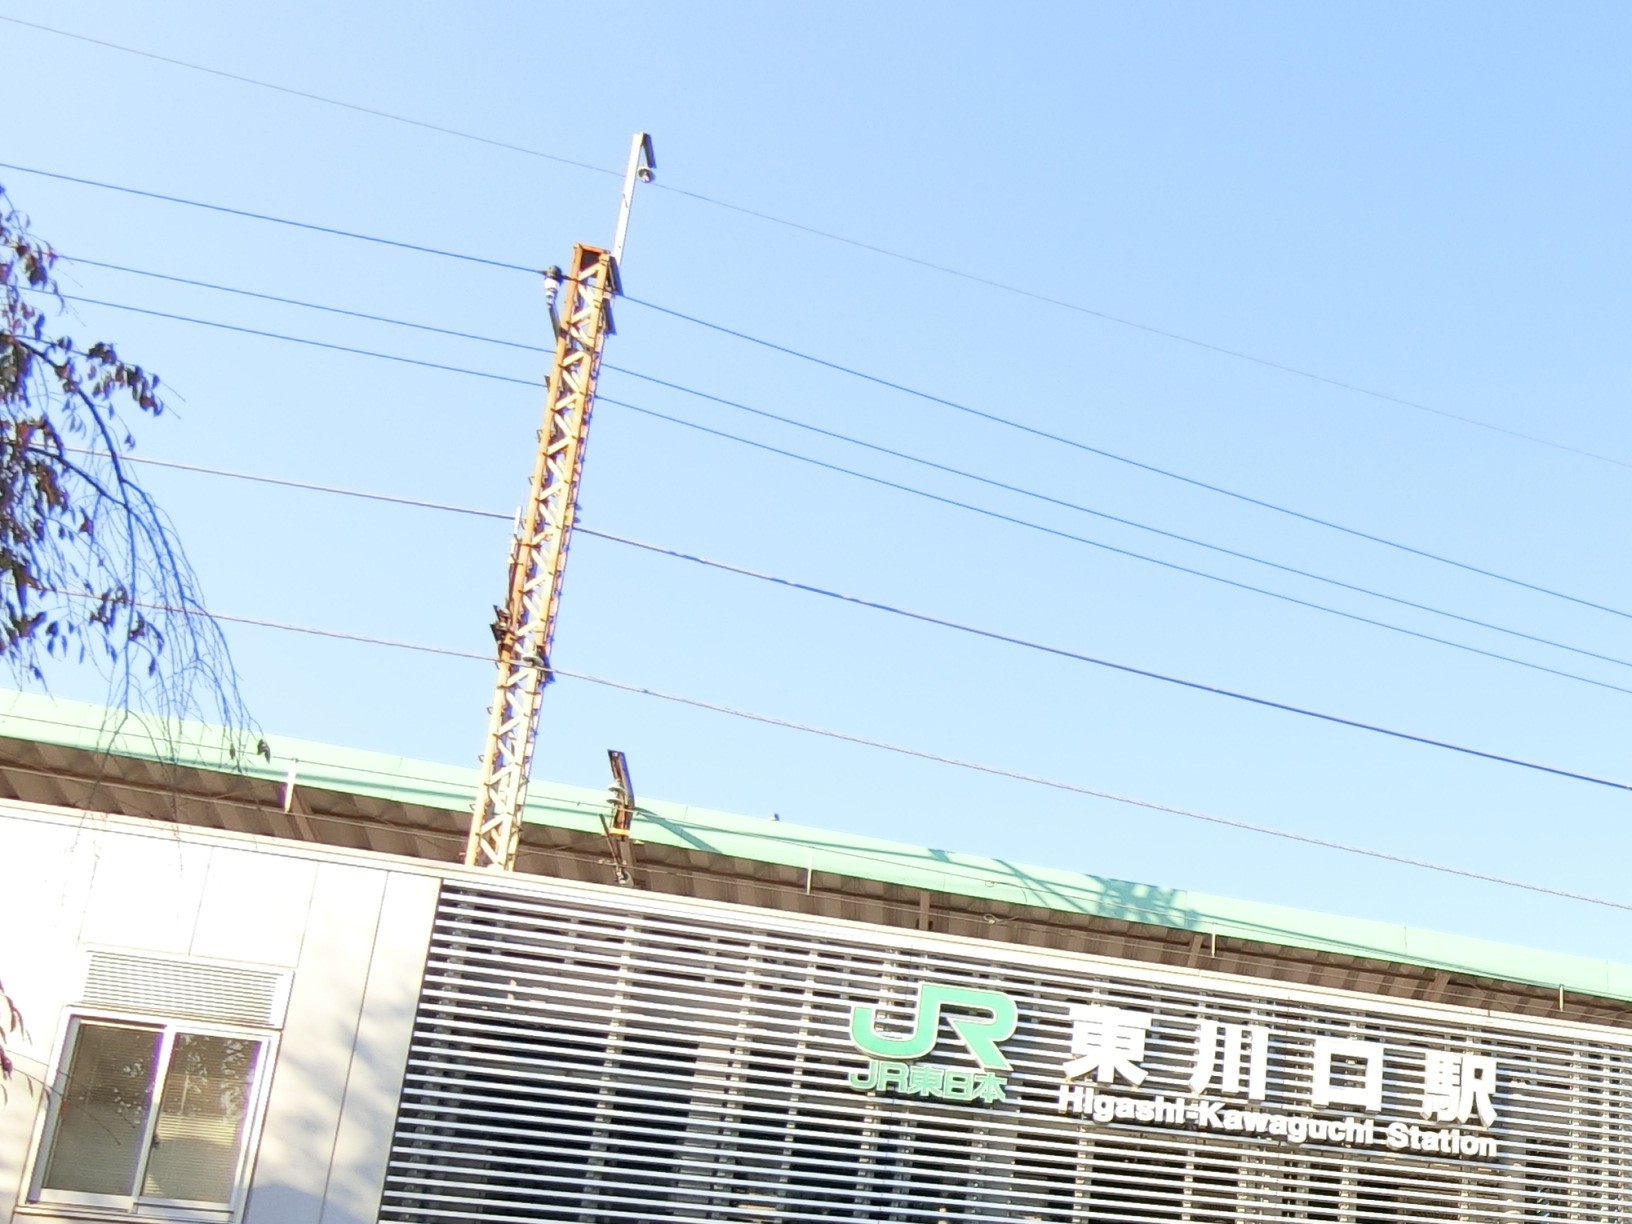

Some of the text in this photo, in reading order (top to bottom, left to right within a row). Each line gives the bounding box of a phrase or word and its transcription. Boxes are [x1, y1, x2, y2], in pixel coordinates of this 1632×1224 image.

[851, 981, 1018, 1071] JR
[849, 1060, 1008, 1103] JR東日本
[1063, 1006, 1498, 1128] 東川口駅
[1058, 1085, 1497, 1157] Higashi-Kawaguchi Station
